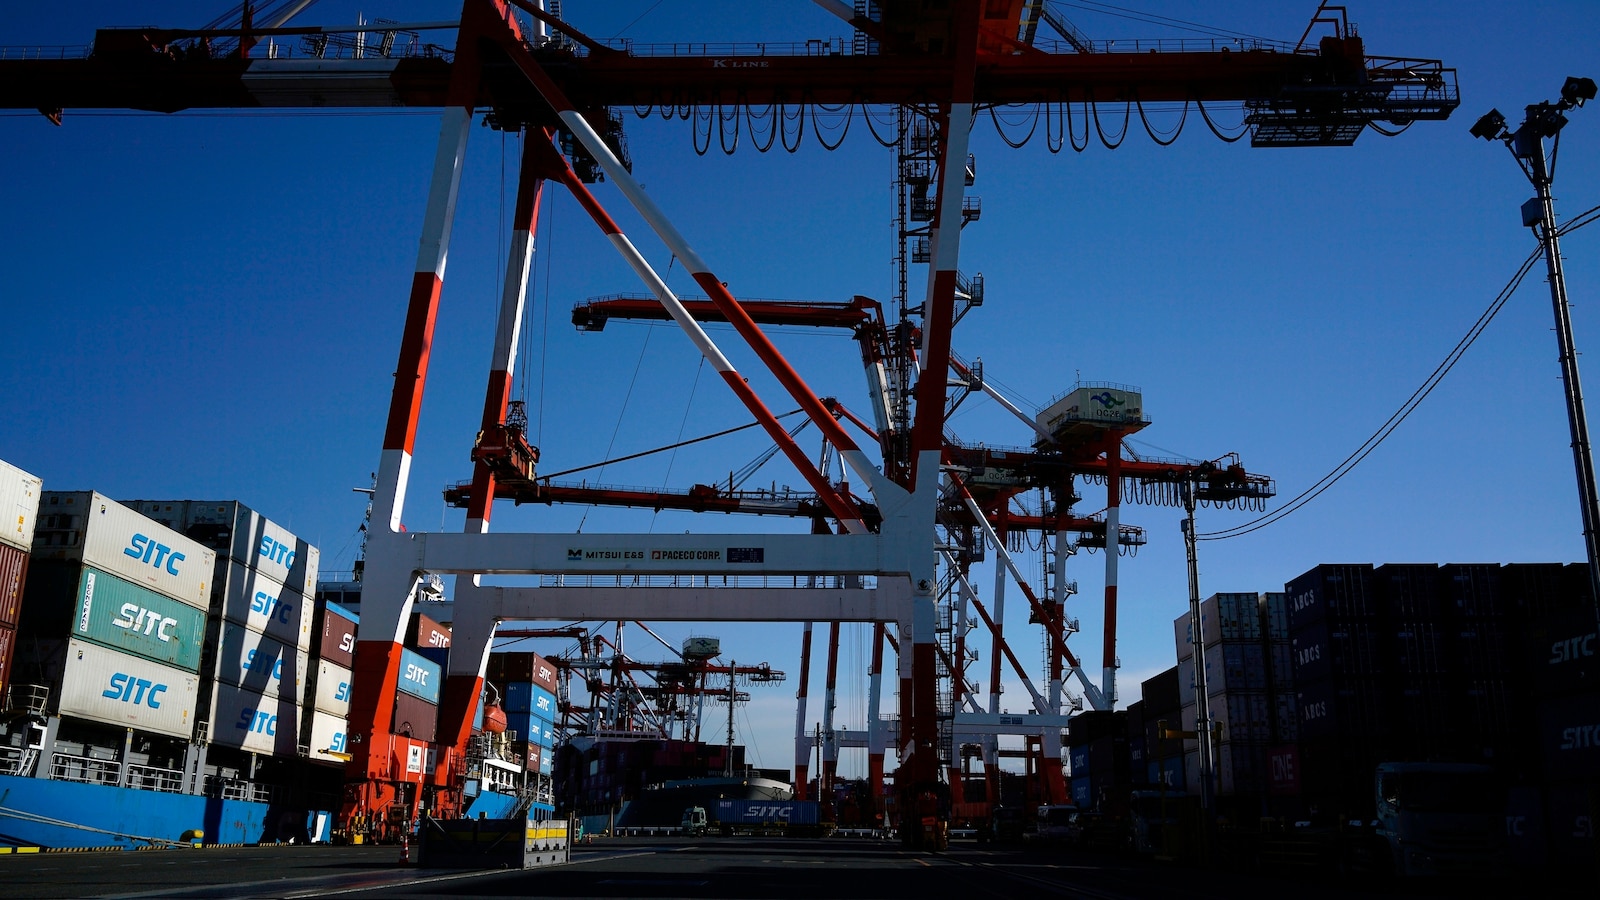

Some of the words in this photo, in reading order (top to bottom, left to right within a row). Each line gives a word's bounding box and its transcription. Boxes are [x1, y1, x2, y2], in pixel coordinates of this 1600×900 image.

[123, 533, 186, 576] SITC
[258, 535, 296, 570] SITC
[585, 551, 621, 559] MITSUI
[624, 551, 644, 559] E&S
[662, 550, 695, 560] PACECO
[696, 551, 721, 560] CORP.
[251, 591, 293, 624] SITC
[112, 602, 177, 642] SITC
[428, 630, 450, 648] SITC
[1549, 633, 1597, 664] SITC
[243, 648, 286, 680] SITC
[404, 663, 430, 687] SITC
[538, 665, 552, 683] SITC
[102, 672, 168, 709] SITC
[536, 695, 550, 712] SITC
[235, 707, 279, 736] SITC
[1272, 754, 1295, 781] ONE
[744, 806, 793, 818] SITC
